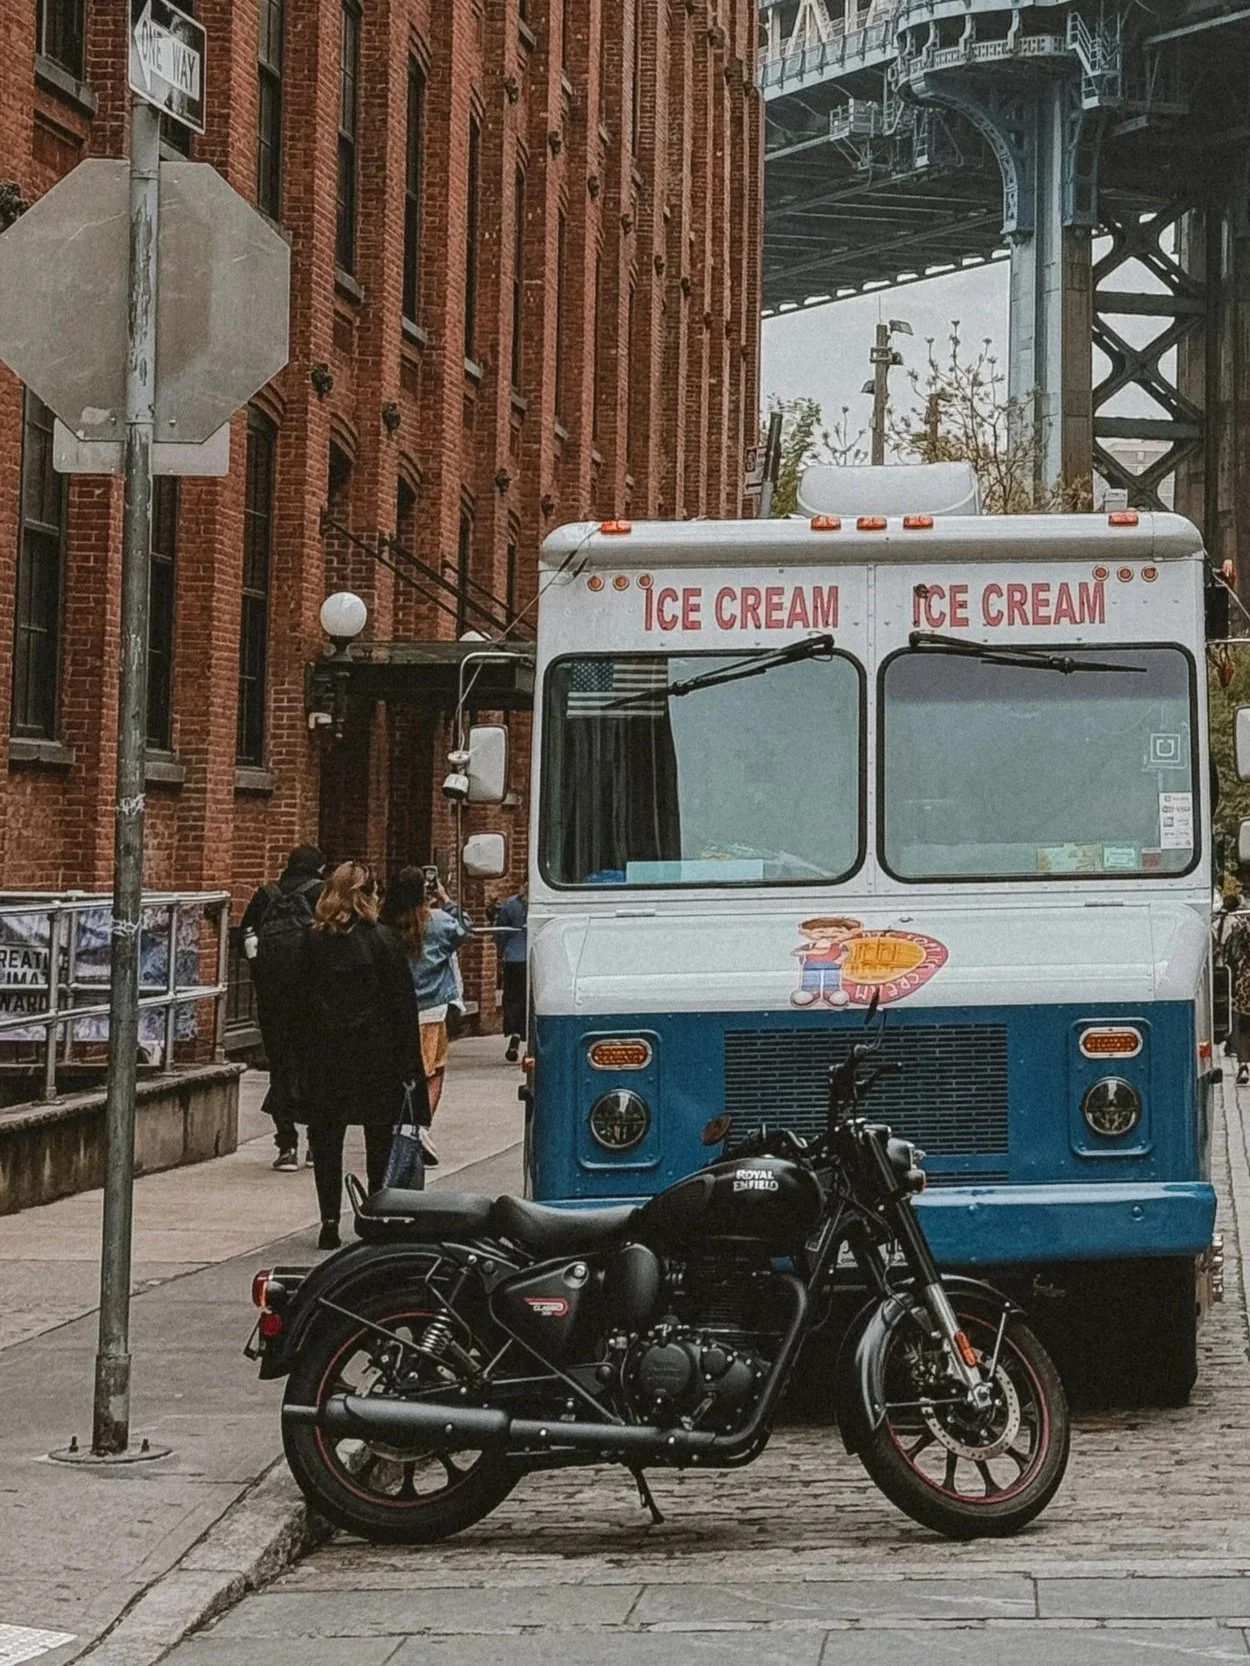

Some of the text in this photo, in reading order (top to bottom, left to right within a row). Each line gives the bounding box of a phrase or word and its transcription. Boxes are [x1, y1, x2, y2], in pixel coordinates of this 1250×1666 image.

[141, 19, 196, 93] ONE WAY
[644, 585, 840, 631] ICE CREAM
[912, 581, 1106, 628] ICE CREAM
[733, 1180, 779, 1192] ENFIELD
[736, 1169, 774, 1180] ROYAL
